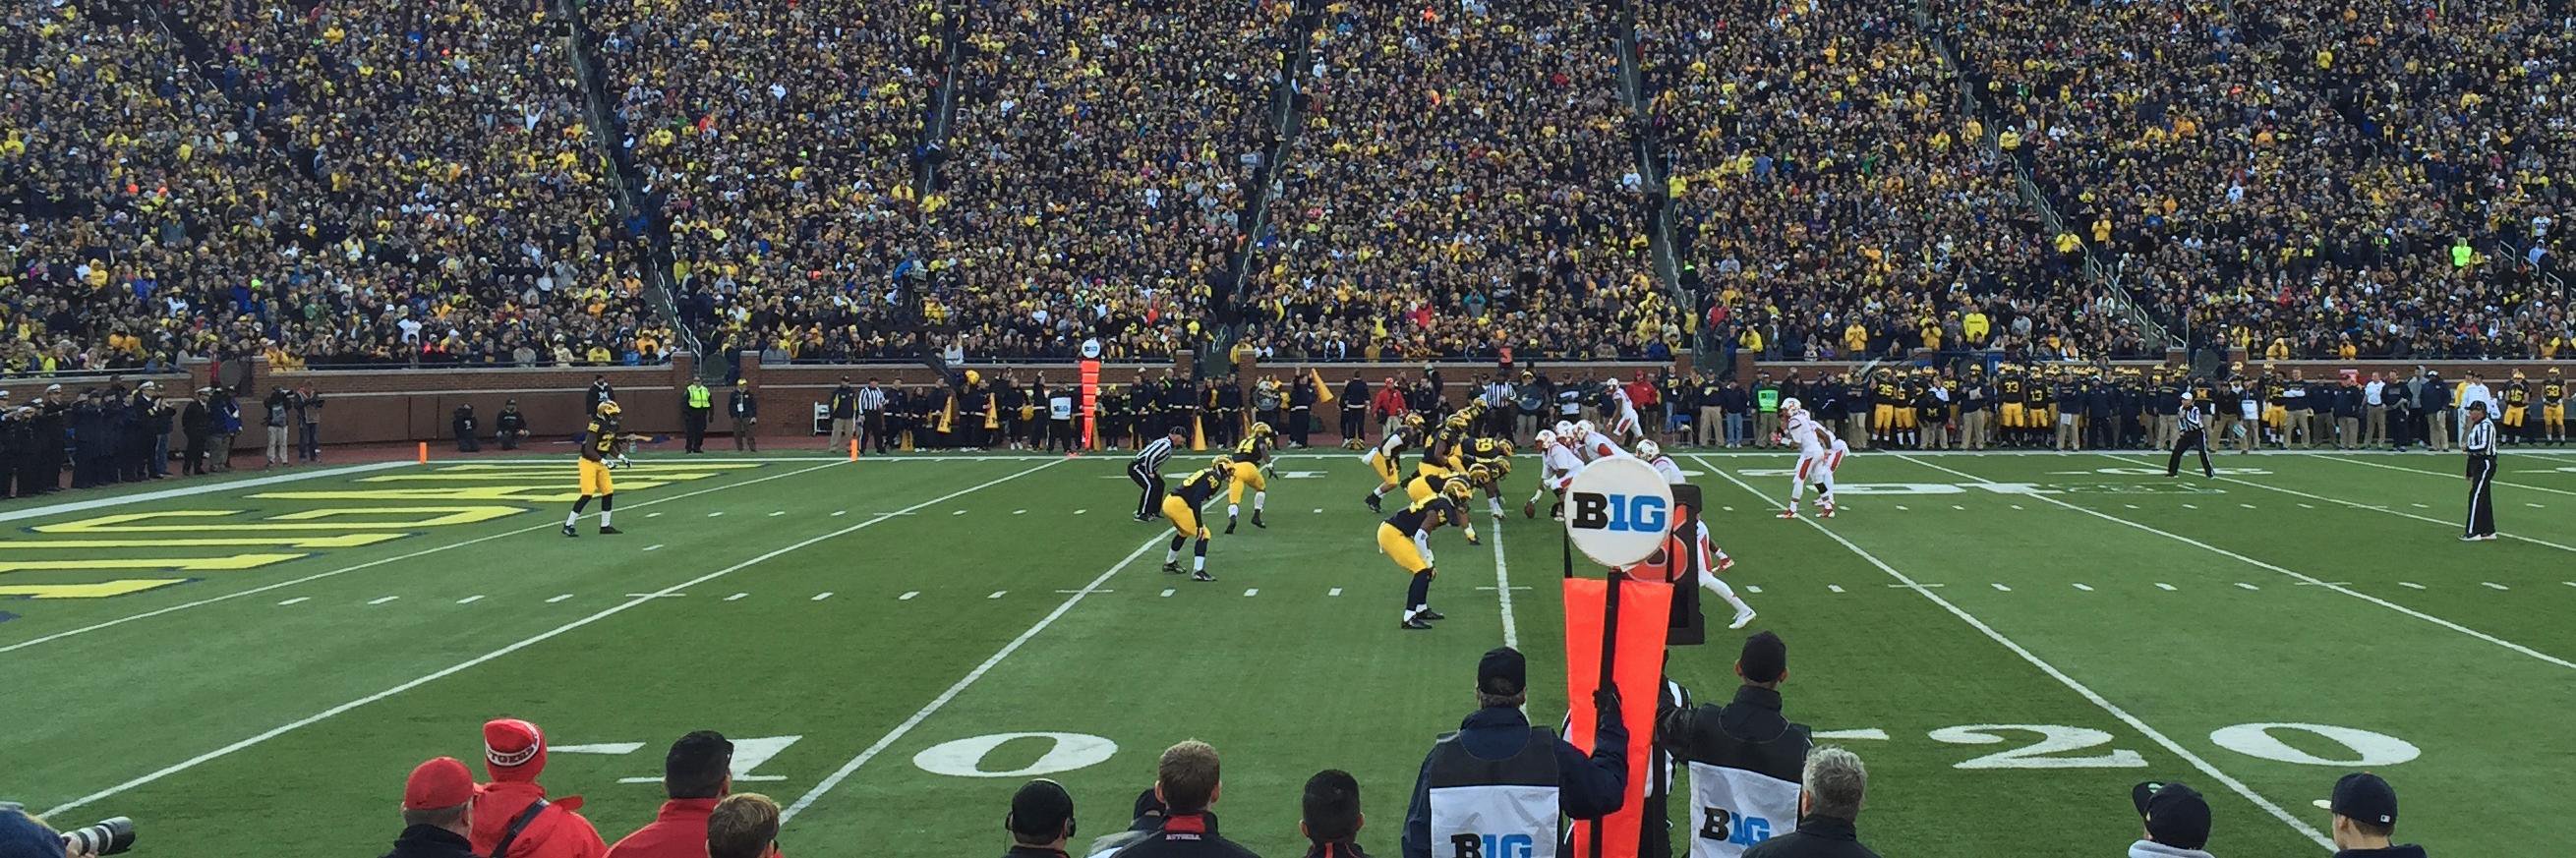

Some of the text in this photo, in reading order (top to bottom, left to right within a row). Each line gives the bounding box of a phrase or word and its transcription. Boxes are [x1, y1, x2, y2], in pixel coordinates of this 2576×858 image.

[1572, 492, 1667, 533] B1G
[1450, 833, 1533, 858] B1G
[1700, 807, 1771, 846] B1G
